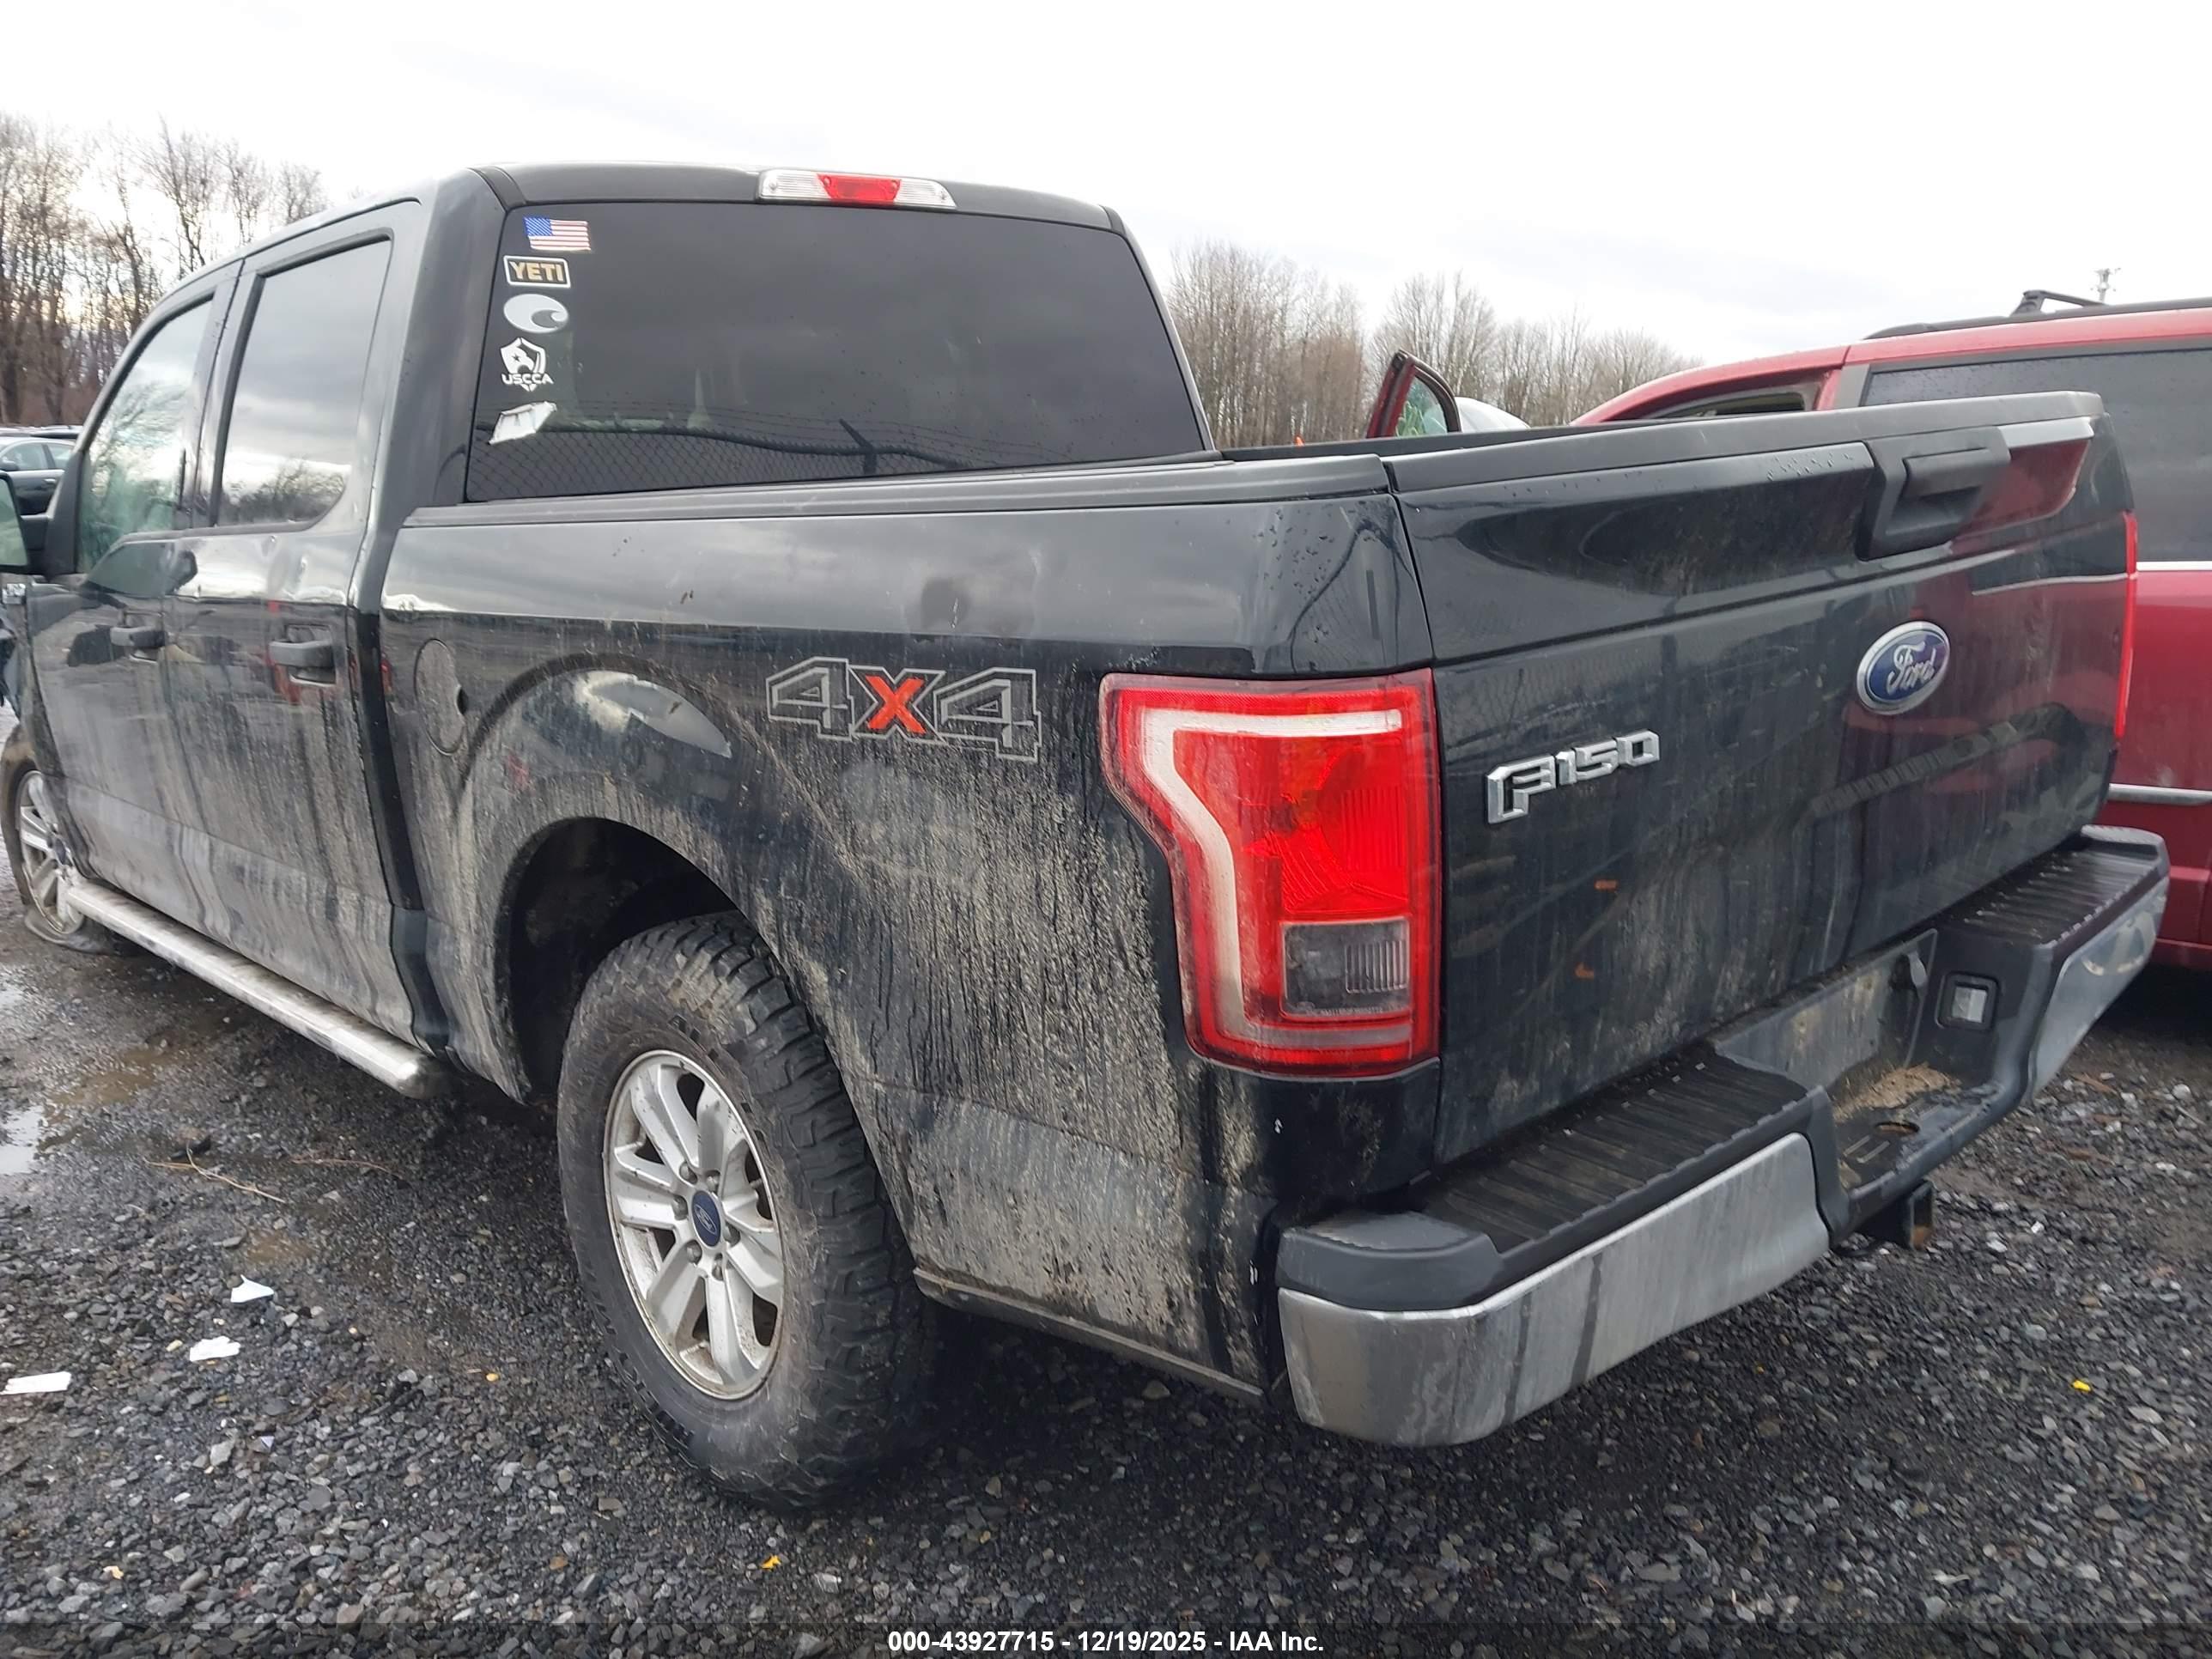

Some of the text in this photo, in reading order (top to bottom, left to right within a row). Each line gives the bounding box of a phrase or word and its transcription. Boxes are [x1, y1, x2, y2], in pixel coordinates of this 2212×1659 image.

[509, 262, 564, 282] YETI
[501, 374, 555, 385] USCCA
[1886, 641, 1936, 695] Ford
